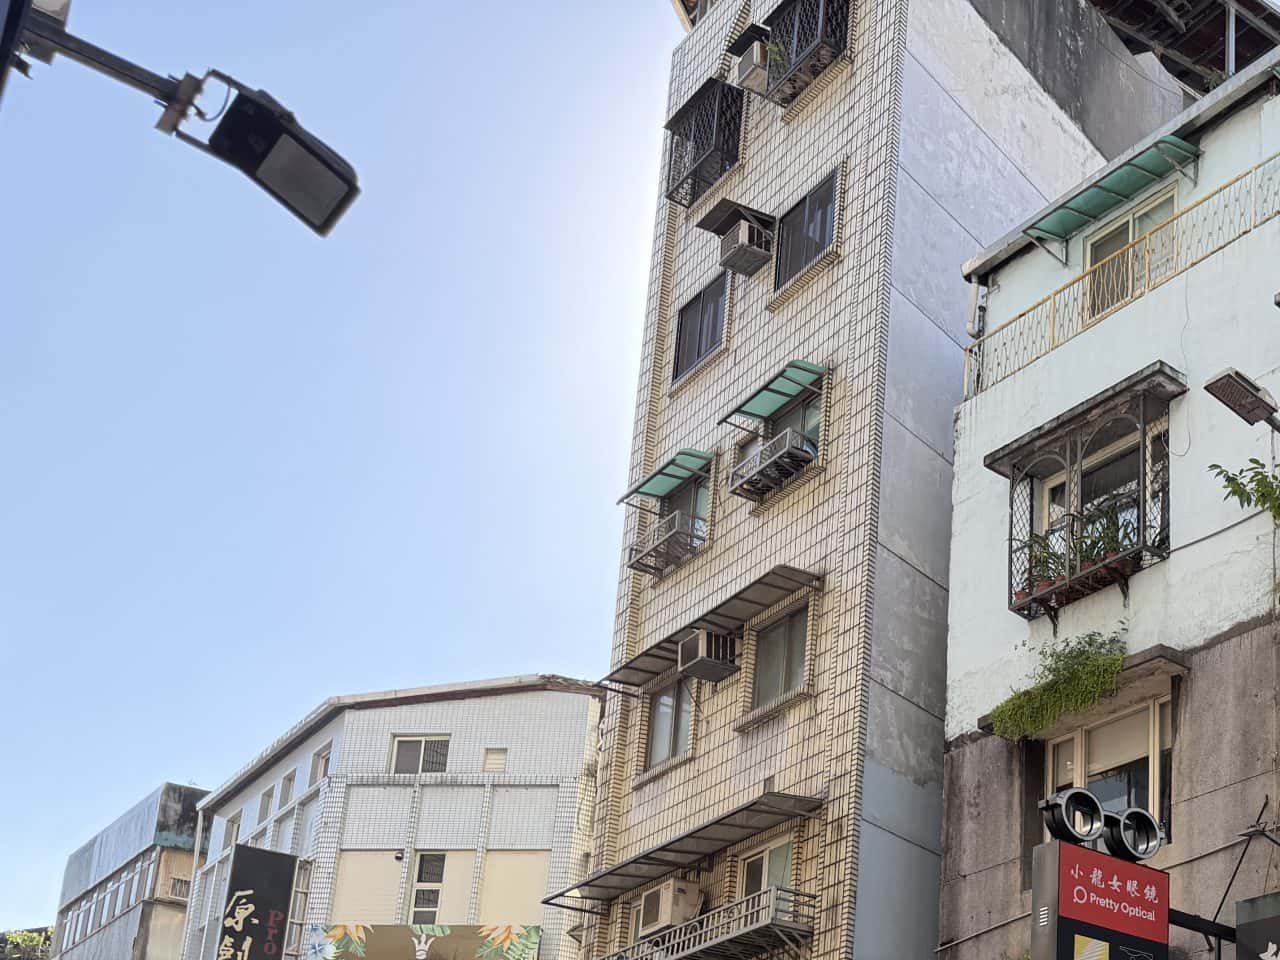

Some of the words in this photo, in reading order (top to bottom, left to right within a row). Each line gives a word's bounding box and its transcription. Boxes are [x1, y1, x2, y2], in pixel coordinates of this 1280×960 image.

[1069, 862, 1159, 904] 小龍女眼鏡
[1089, 891, 1120, 914] Pretty
[1120, 900, 1156, 923] Optical
[263, 910, 286, 956] Pro
